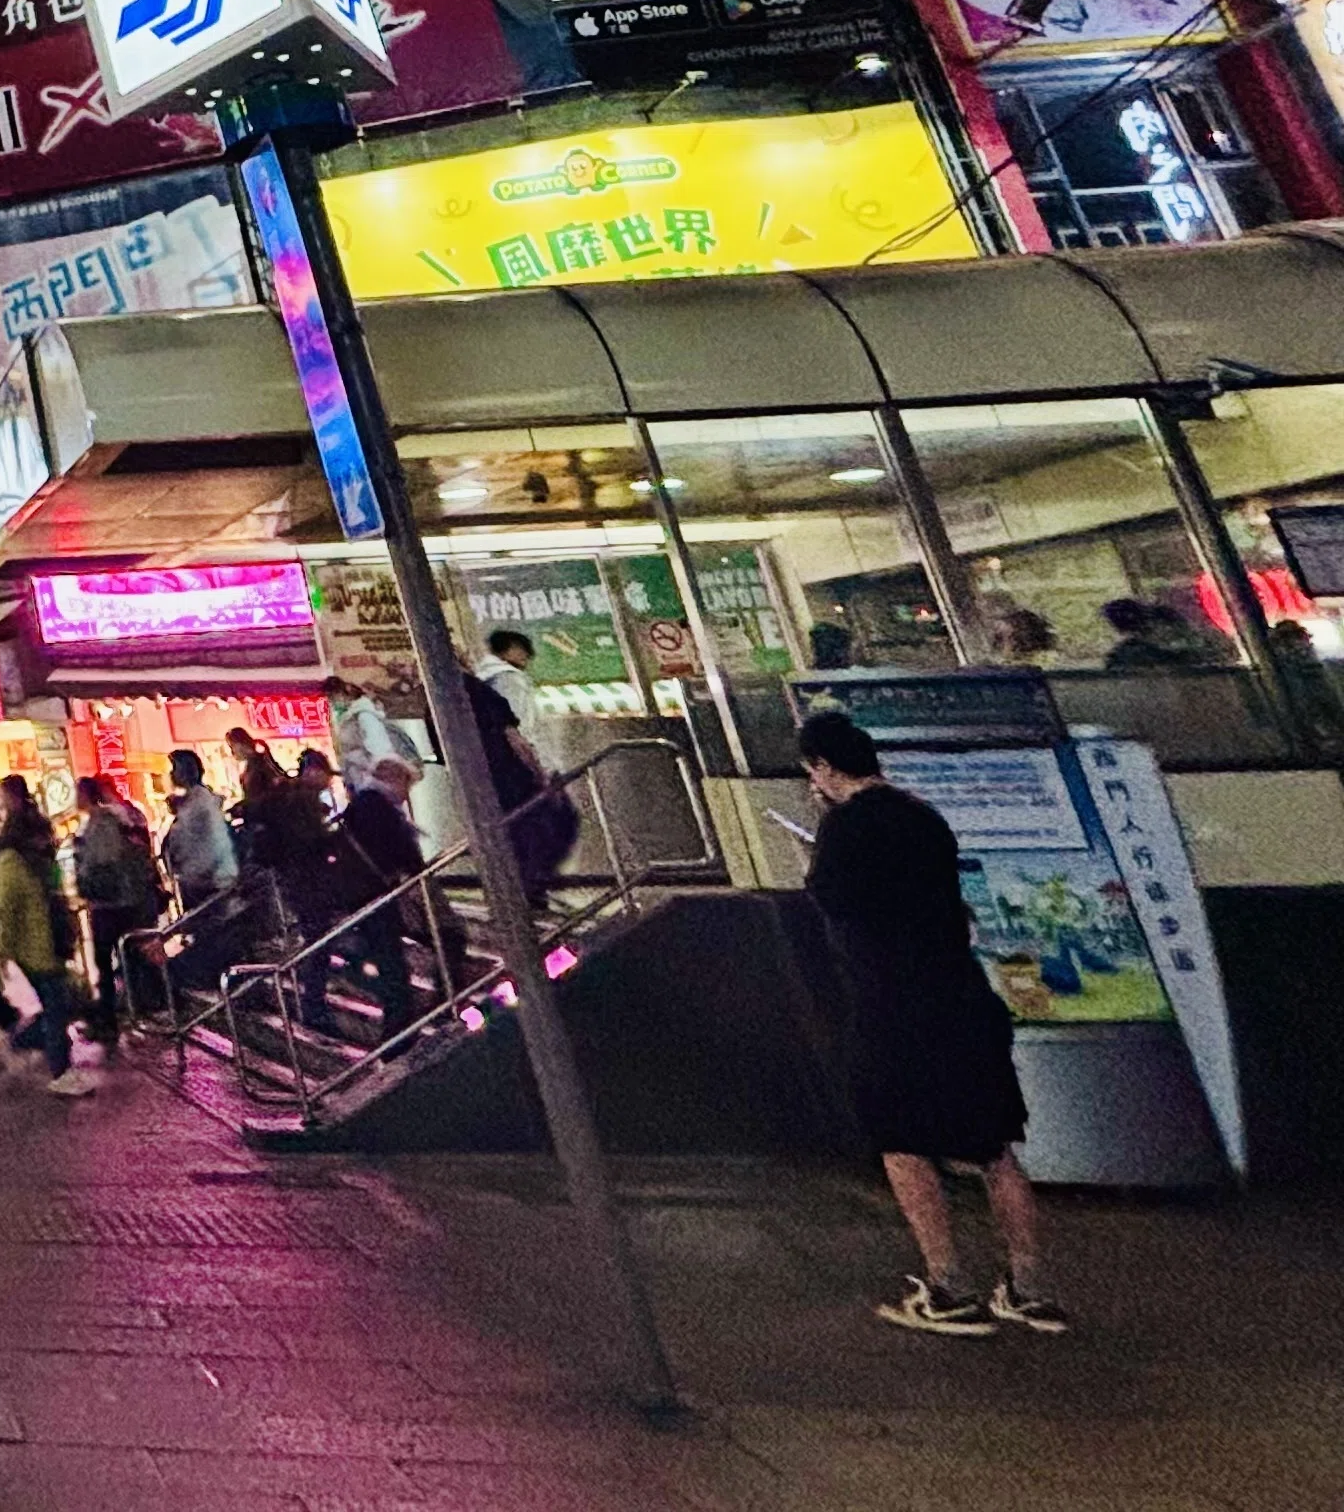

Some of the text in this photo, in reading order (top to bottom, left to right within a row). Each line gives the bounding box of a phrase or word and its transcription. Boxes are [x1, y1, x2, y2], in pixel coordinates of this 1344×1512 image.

[604, 2, 689, 25] App Store
[498, 158, 671, 199] POTATO CORNER
[486, 206, 718, 290] 風靡世界
